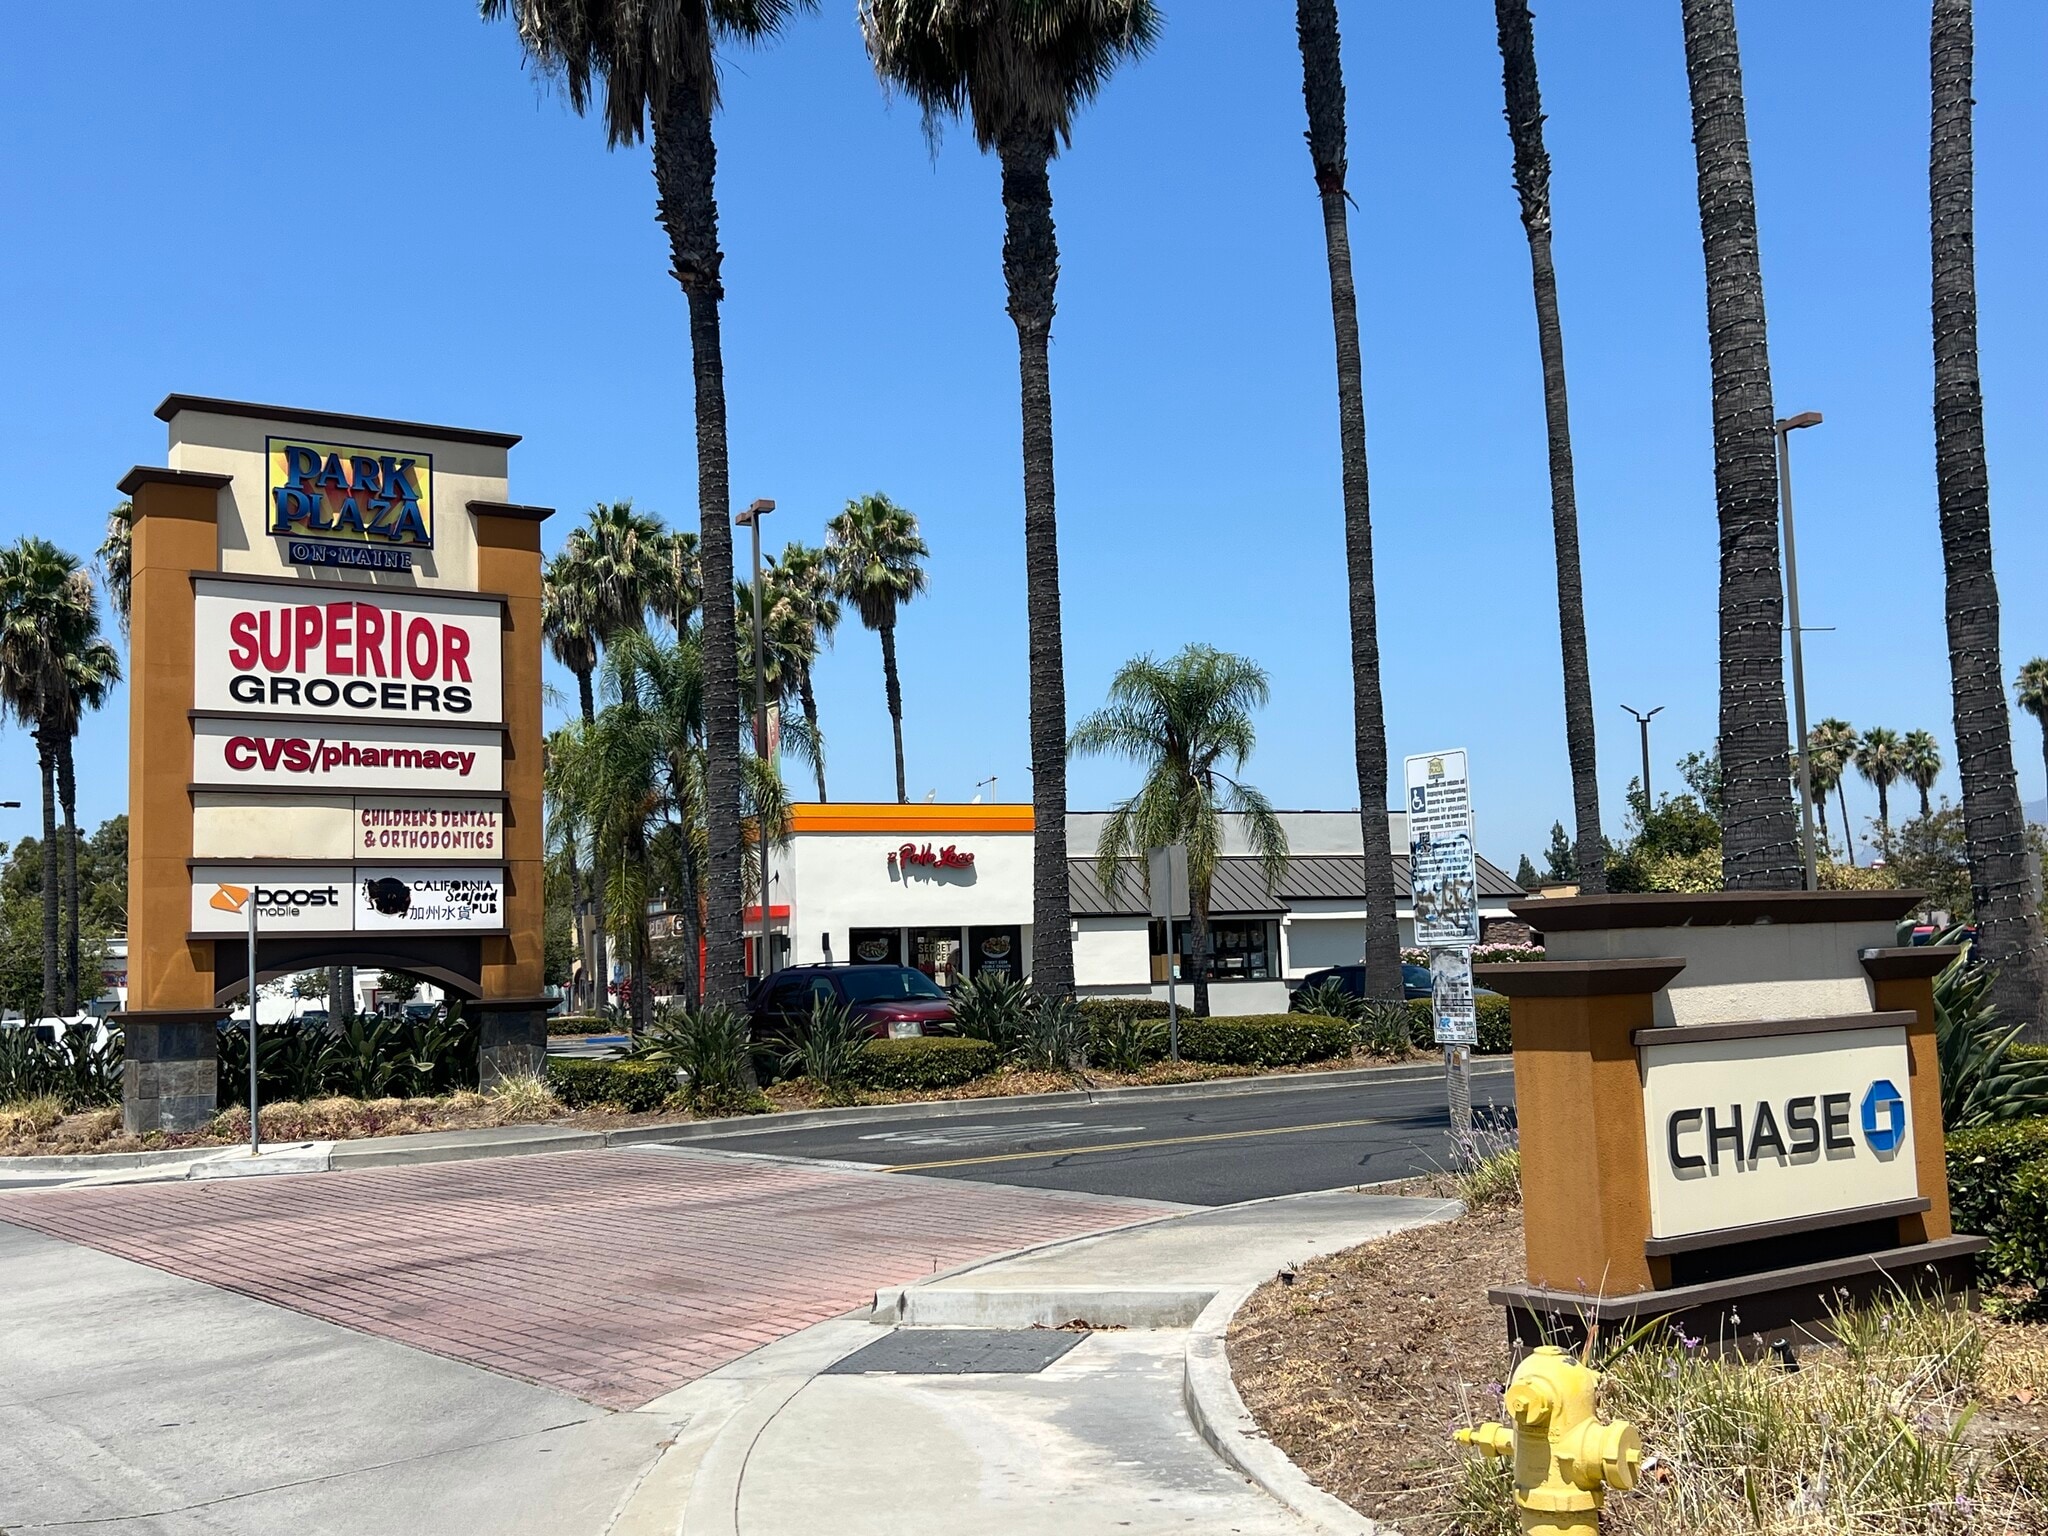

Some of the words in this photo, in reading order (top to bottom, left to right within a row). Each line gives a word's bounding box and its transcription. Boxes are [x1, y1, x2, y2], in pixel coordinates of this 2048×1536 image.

[283, 445, 420, 501] PARK
[272, 486, 432, 544] PLAZA
[229, 601, 473, 683] SUPERIOR
[229, 675, 473, 713] GROCERS
[224, 735, 476, 776] CVS/pharmacy
[361, 807, 437, 827] CHILDREN'S
[441, 810, 497, 828] DENTAL
[364, 829, 376, 848] &
[380, 830, 494, 849] ORTHODONTICS
[898, 842, 937, 870] Pollo
[932, 844, 975, 869] Loco
[254, 885, 339, 907] boost
[413, 880, 493, 892] CALIFORNIA
[445, 888, 498, 905] Seafood
[256, 907, 300, 917] mobile
[409, 905, 472, 921] 加州水貨
[471, 903, 497, 914] PUB
[918, 953, 952, 962] AUCE?
[1666, 1092, 1856, 1170] CHASE
